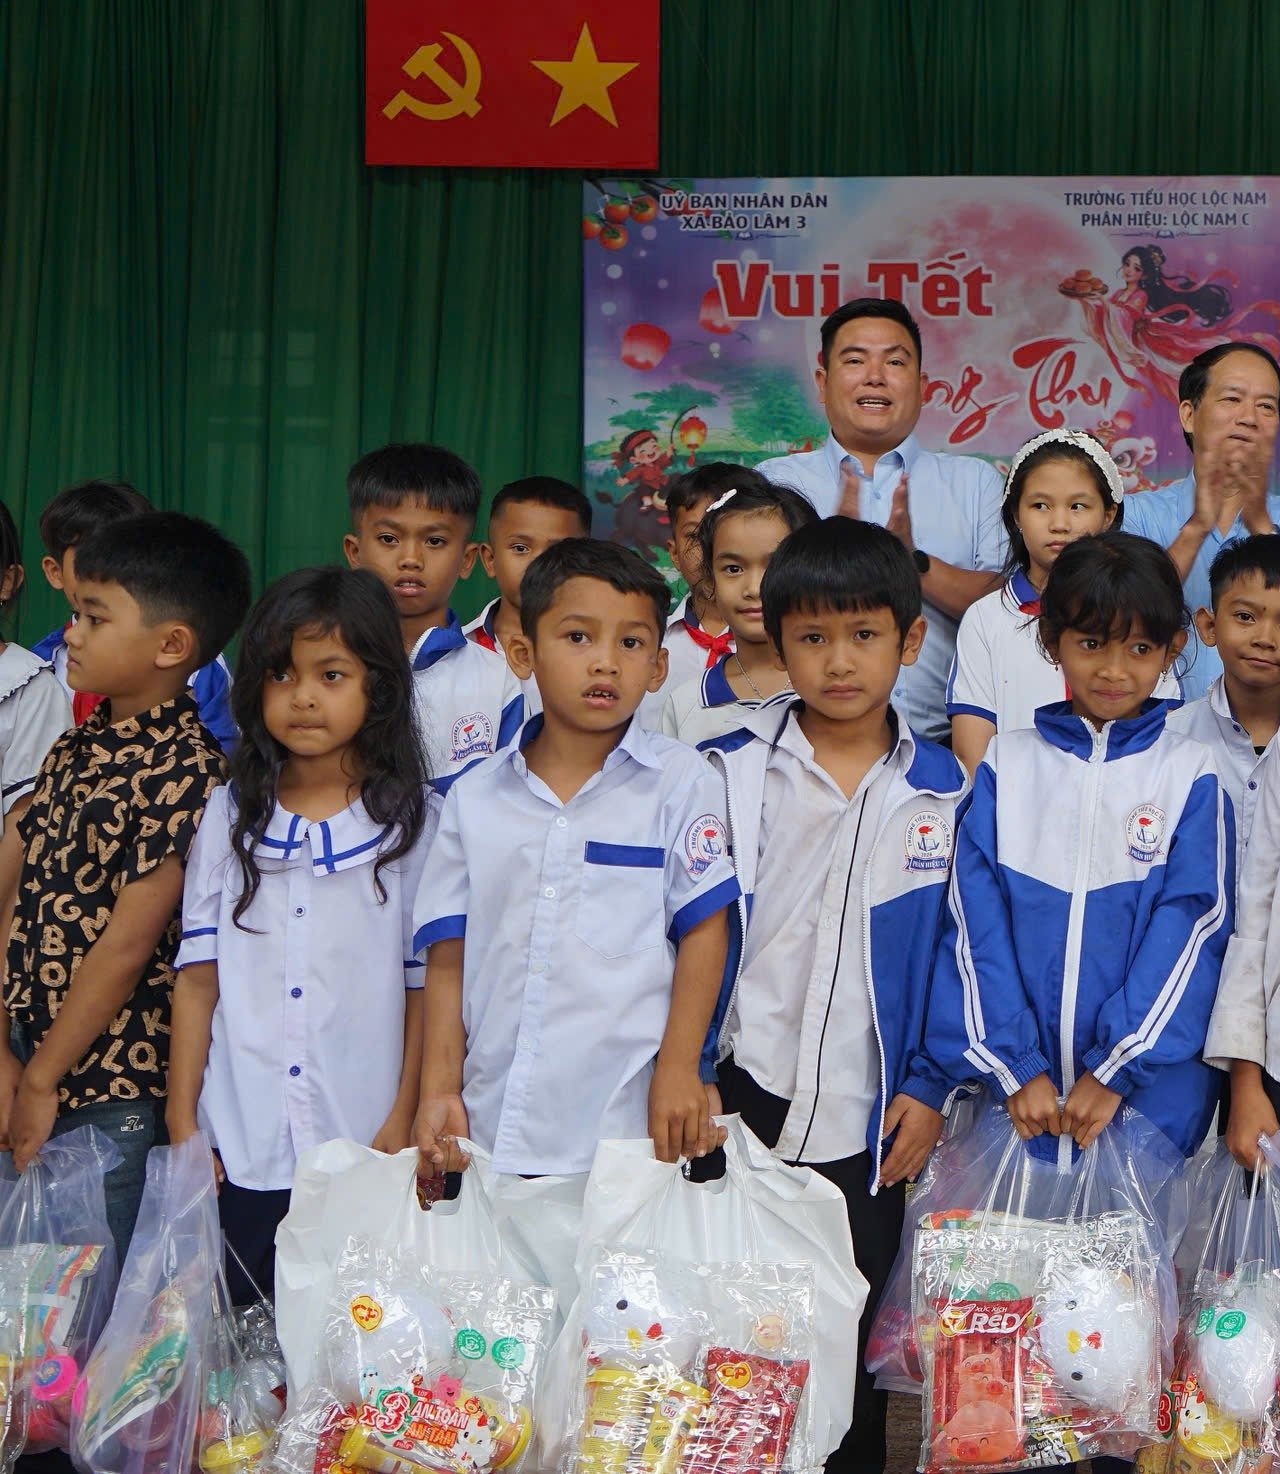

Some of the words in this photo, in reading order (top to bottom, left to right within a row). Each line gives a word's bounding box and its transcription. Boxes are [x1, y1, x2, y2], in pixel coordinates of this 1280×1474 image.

[690, 194, 727, 209] BAN
[733, 192, 785, 209] NHÂN
[790, 192, 828, 209] DÂN
[1064, 189, 1126, 206] TRƯỜNG
[1131, 188, 1164, 206] TIỂU
[1168, 192, 1198, 207] HỌC
[1202, 190, 1229, 207] LỘC
[1233, 192, 1267, 206] NAM
[712, 213, 748, 229] BẢO
[754, 213, 790, 229] LÂM
[796, 215, 806, 229] 3
[1081, 210, 1123, 227] PHÂN
[1127, 212, 1168, 229] HIỆU:
[1172, 210, 1199, 229] LỘC
[1204, 213, 1237, 226] NAM
[1242, 213, 1250, 226] C
[715, 262, 840, 317] Vui
[867, 252, 993, 317] Tết
[1012, 337, 1112, 429] Thu
[39, 924, 67, 956] B
[39, 961, 67, 987] O
[721, 1366, 748, 1380] CP
[663, 1405, 677, 1418] 15g
